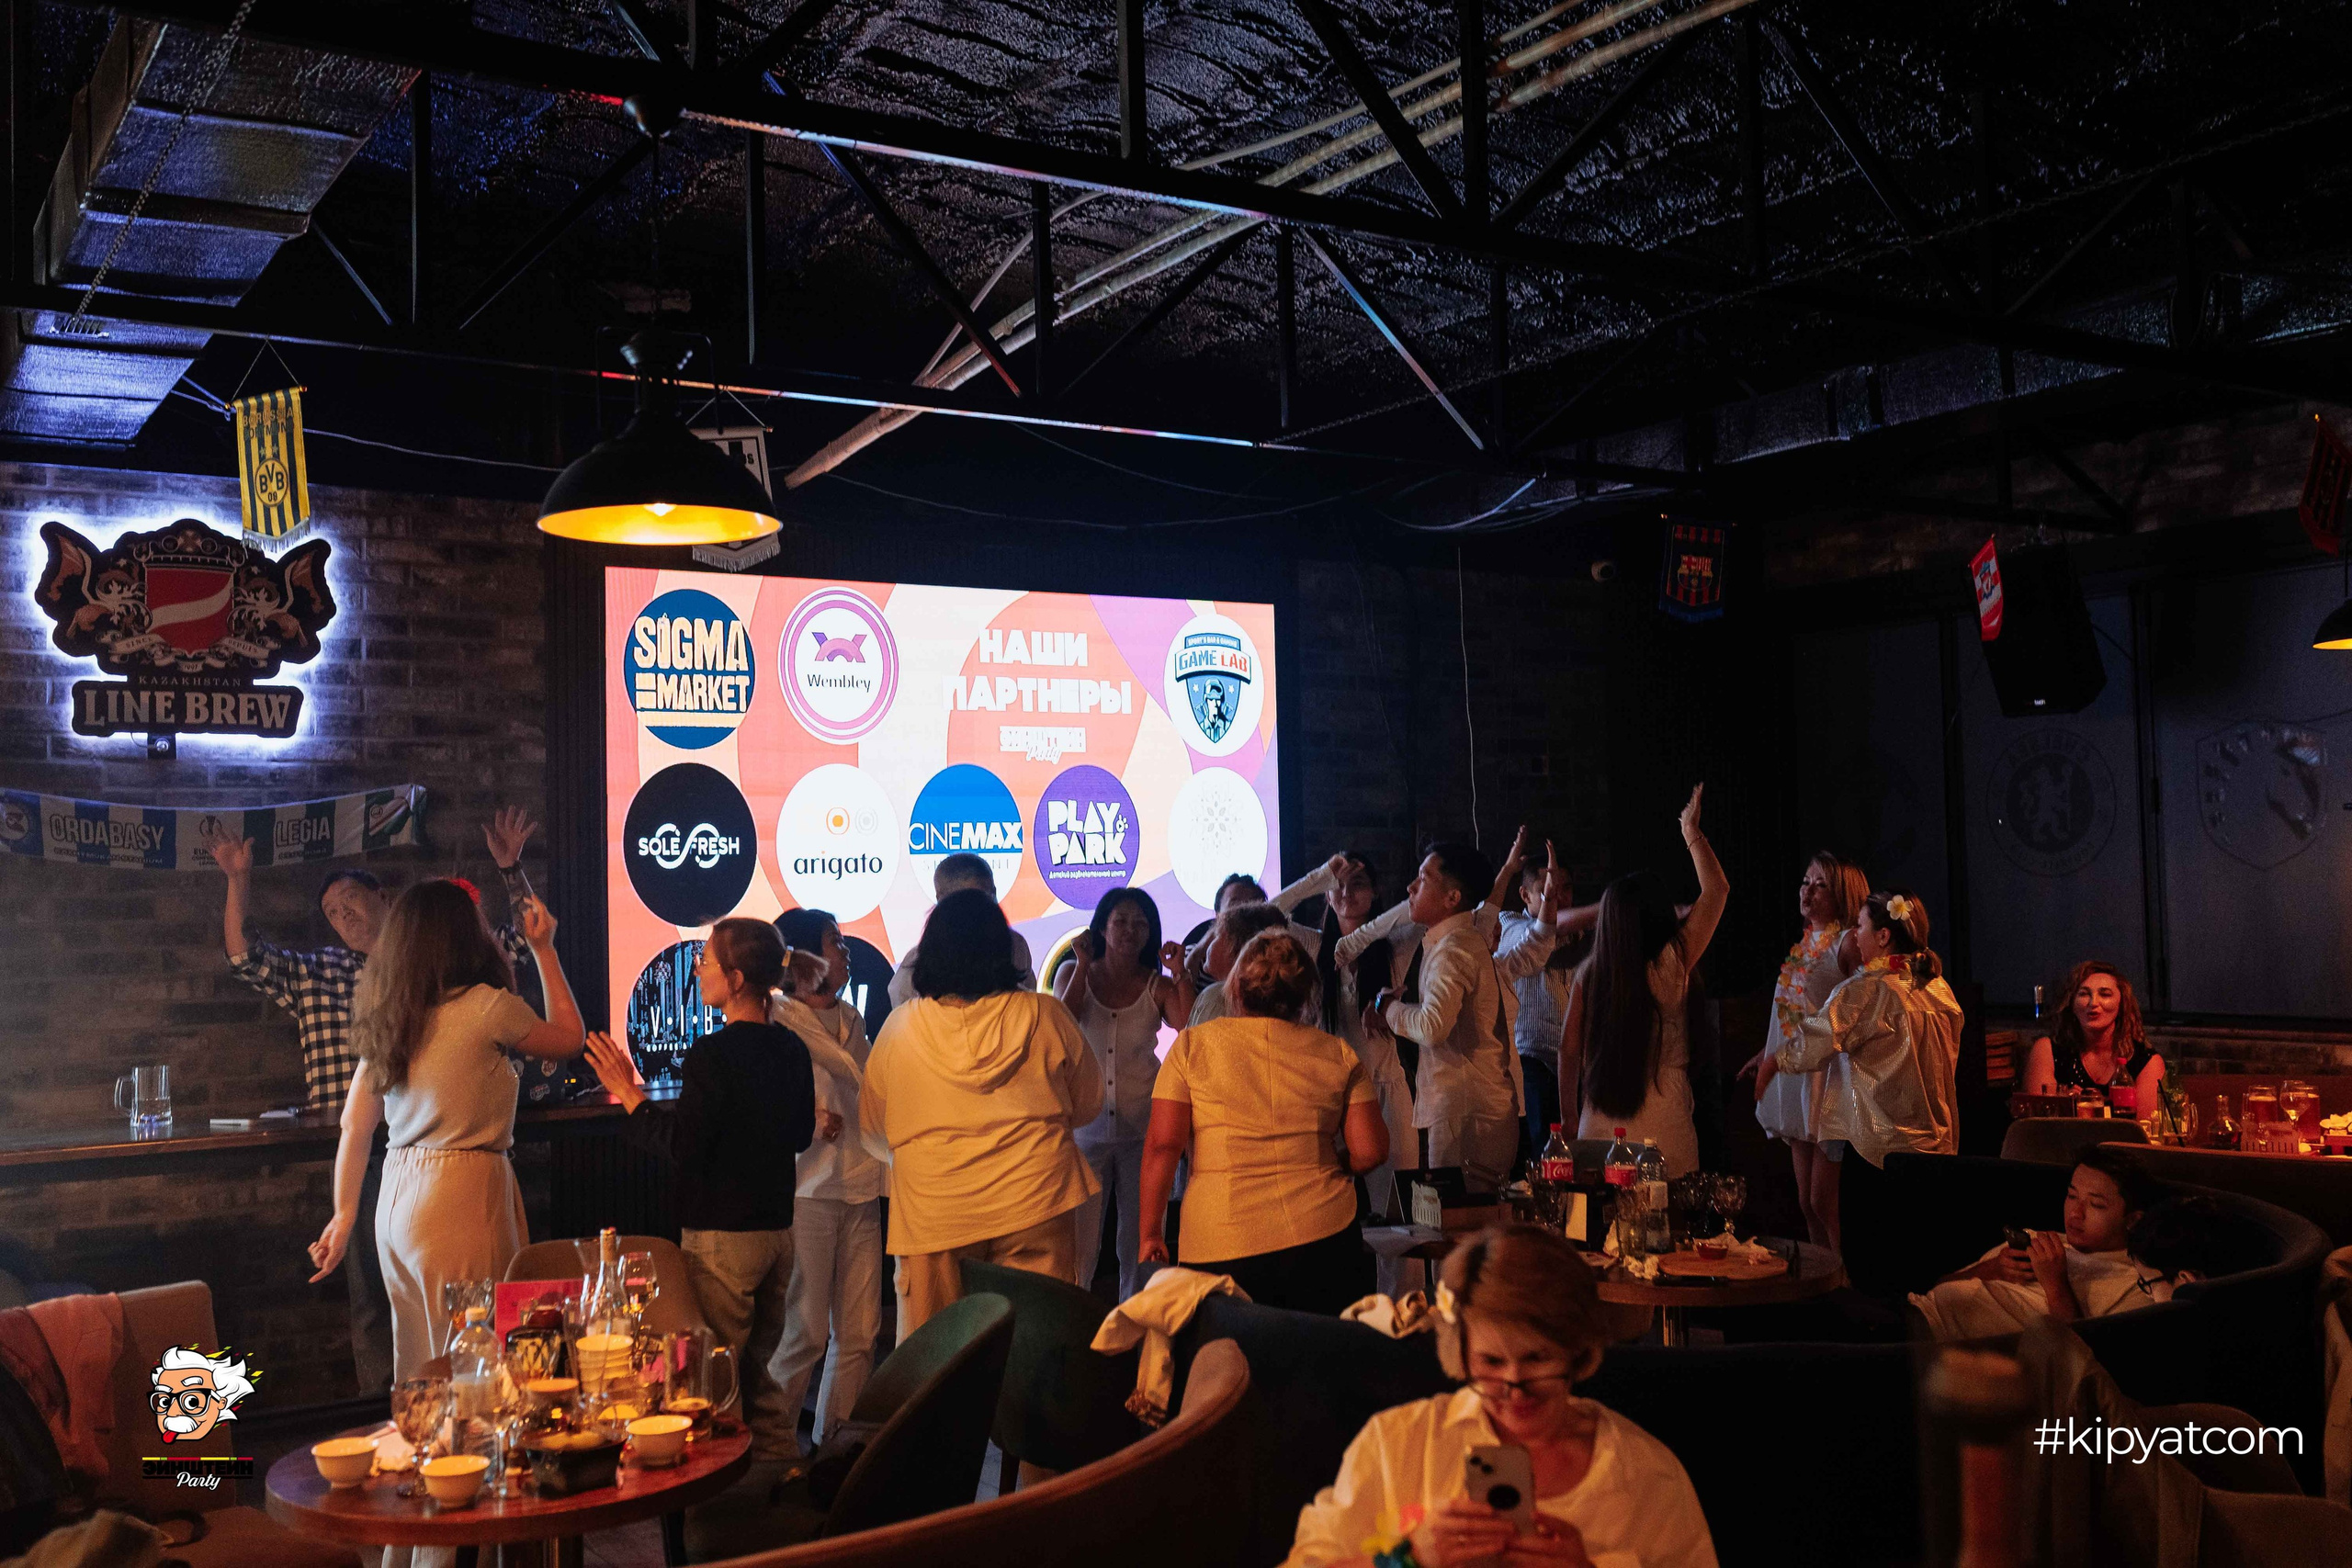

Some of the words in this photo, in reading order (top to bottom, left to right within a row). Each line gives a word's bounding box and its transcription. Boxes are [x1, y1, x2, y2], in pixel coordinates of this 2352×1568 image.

[259, 463, 285, 493] BVB
[634, 613, 749, 671] SIGMA
[978, 628, 1088, 667] НАШИ
[1179, 650, 1217, 671] GAME
[1221, 651, 1248, 672] LAB
[139, 675, 242, 687] KAZAKHSTAN
[657, 673, 750, 713] MARKET
[808, 674, 871, 693] Wembley
[84, 690, 175, 727] LINE
[185, 692, 291, 728] BREW
[1047, 799, 1121, 833] PLAY
[49, 813, 164, 852] ORDABASY
[275, 817, 332, 848] LEGIA
[639, 837, 680, 856] SOLE
[689, 836, 740, 855] FRESH
[909, 821, 1023, 851] CINEMAX
[1047, 831, 1127, 865] PARK
[794, 851, 883, 881] arigato
